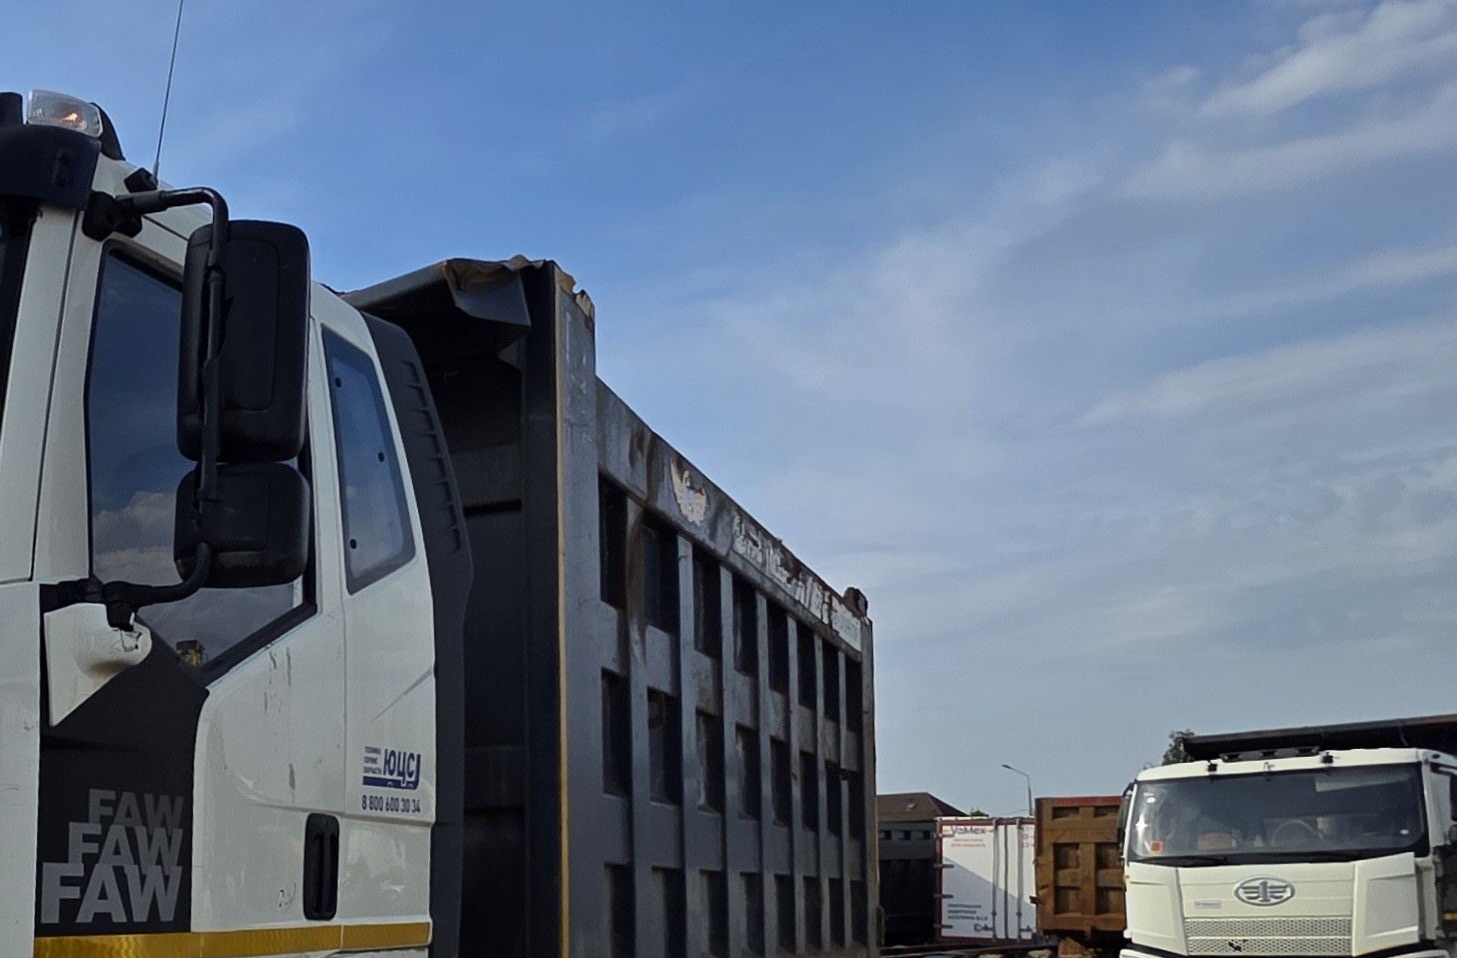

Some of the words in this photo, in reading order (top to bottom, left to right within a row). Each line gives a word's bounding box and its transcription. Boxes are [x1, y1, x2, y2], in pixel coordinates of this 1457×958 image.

[89, 788, 184, 836] FAW
[362, 794, 367, 810] 8
[369, 795, 383, 811] 800
[401, 798, 410, 813] 30
[68, 821, 183, 875] FAW
[41, 862, 183, 923] FAW
